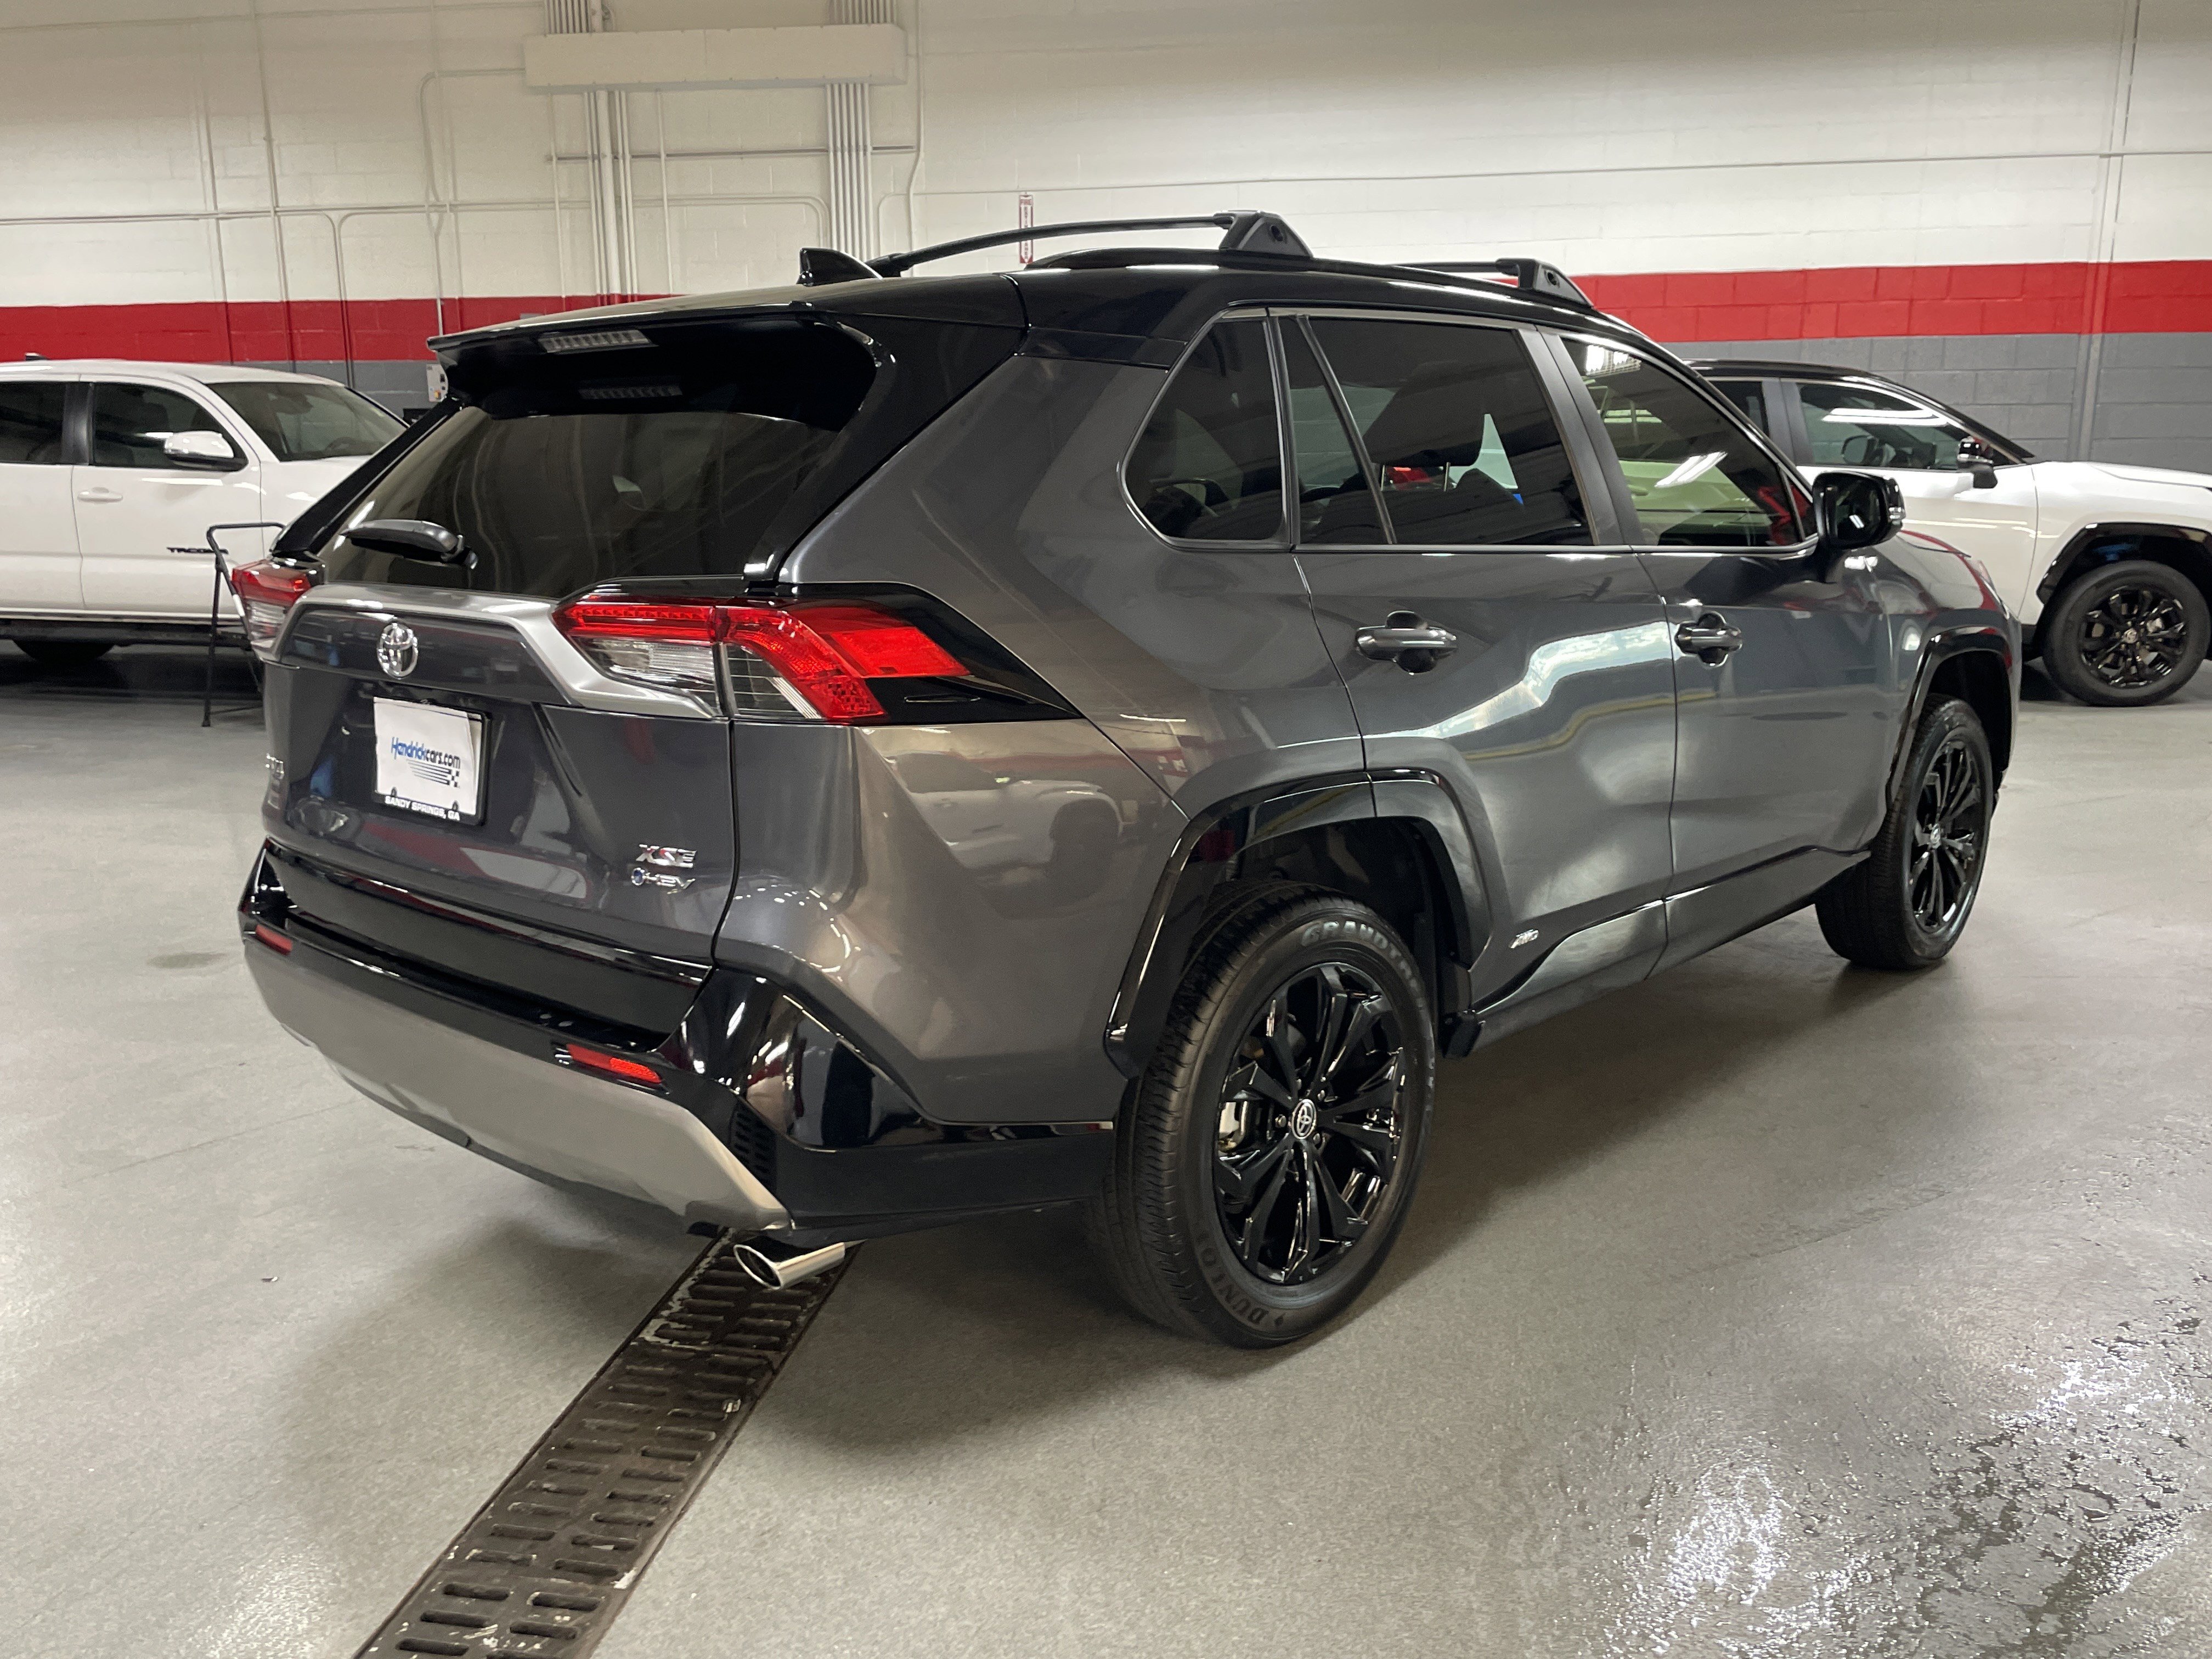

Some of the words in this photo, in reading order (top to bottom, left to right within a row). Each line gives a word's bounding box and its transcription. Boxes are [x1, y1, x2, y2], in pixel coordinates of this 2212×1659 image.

[385, 796, 411, 809] SANDY
[411, 802, 447, 819] SPRINGS,
[448, 810, 460, 821] GA
[635, 844, 697, 868] XSE
